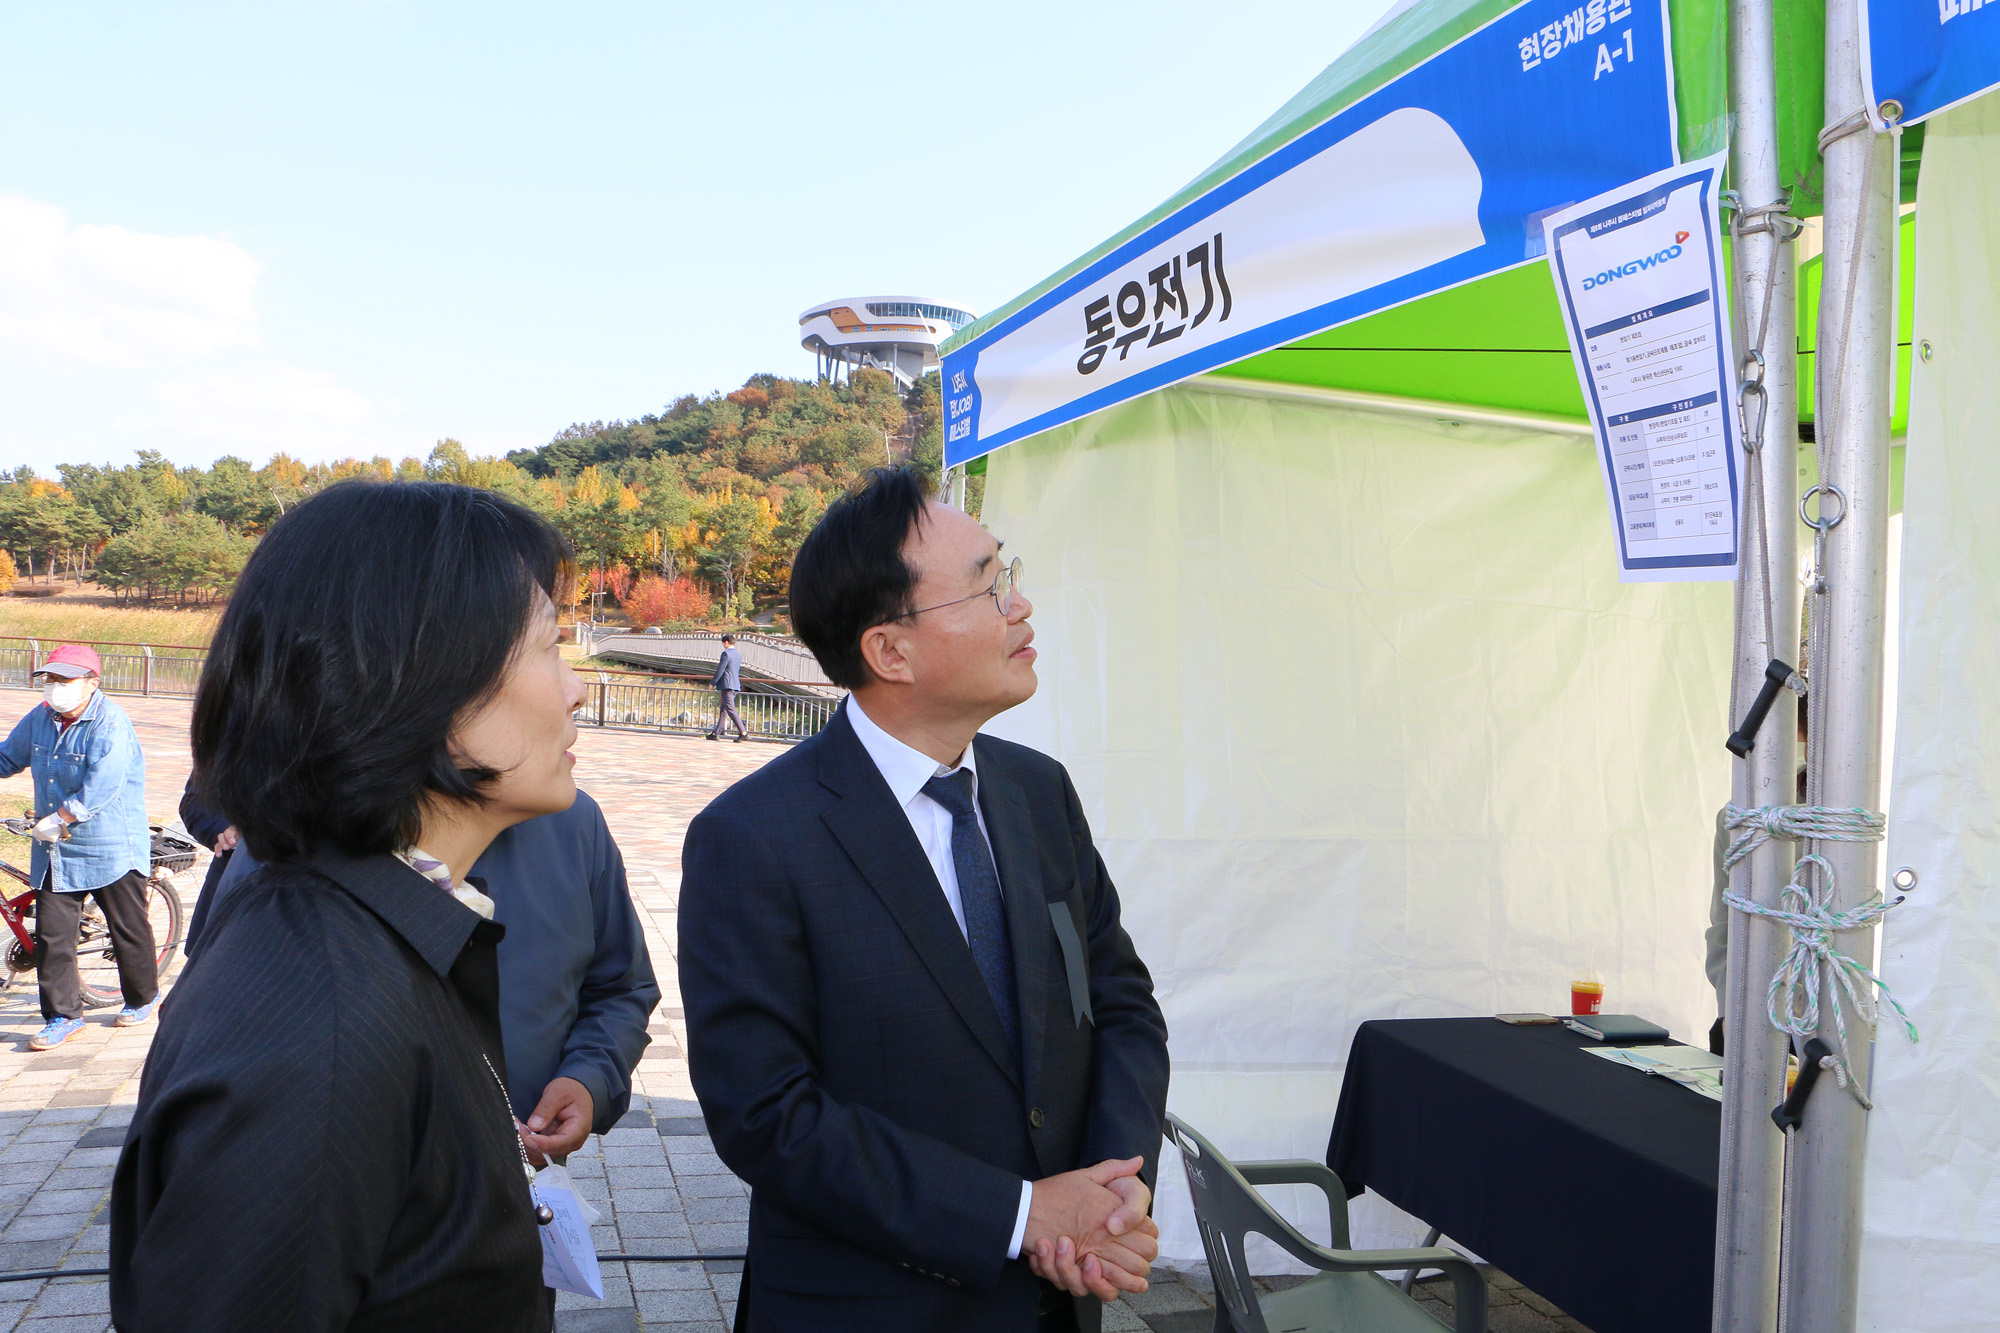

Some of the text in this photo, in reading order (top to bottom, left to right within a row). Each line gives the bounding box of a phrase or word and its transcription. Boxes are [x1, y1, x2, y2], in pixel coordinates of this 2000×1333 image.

[1518, 0, 1632, 72] 현장채용관
[1594, 28, 1634, 81] A-1
[1582, 244, 1682, 291] DONGWOO
[1077, 232, 1232, 375] 동우전기
